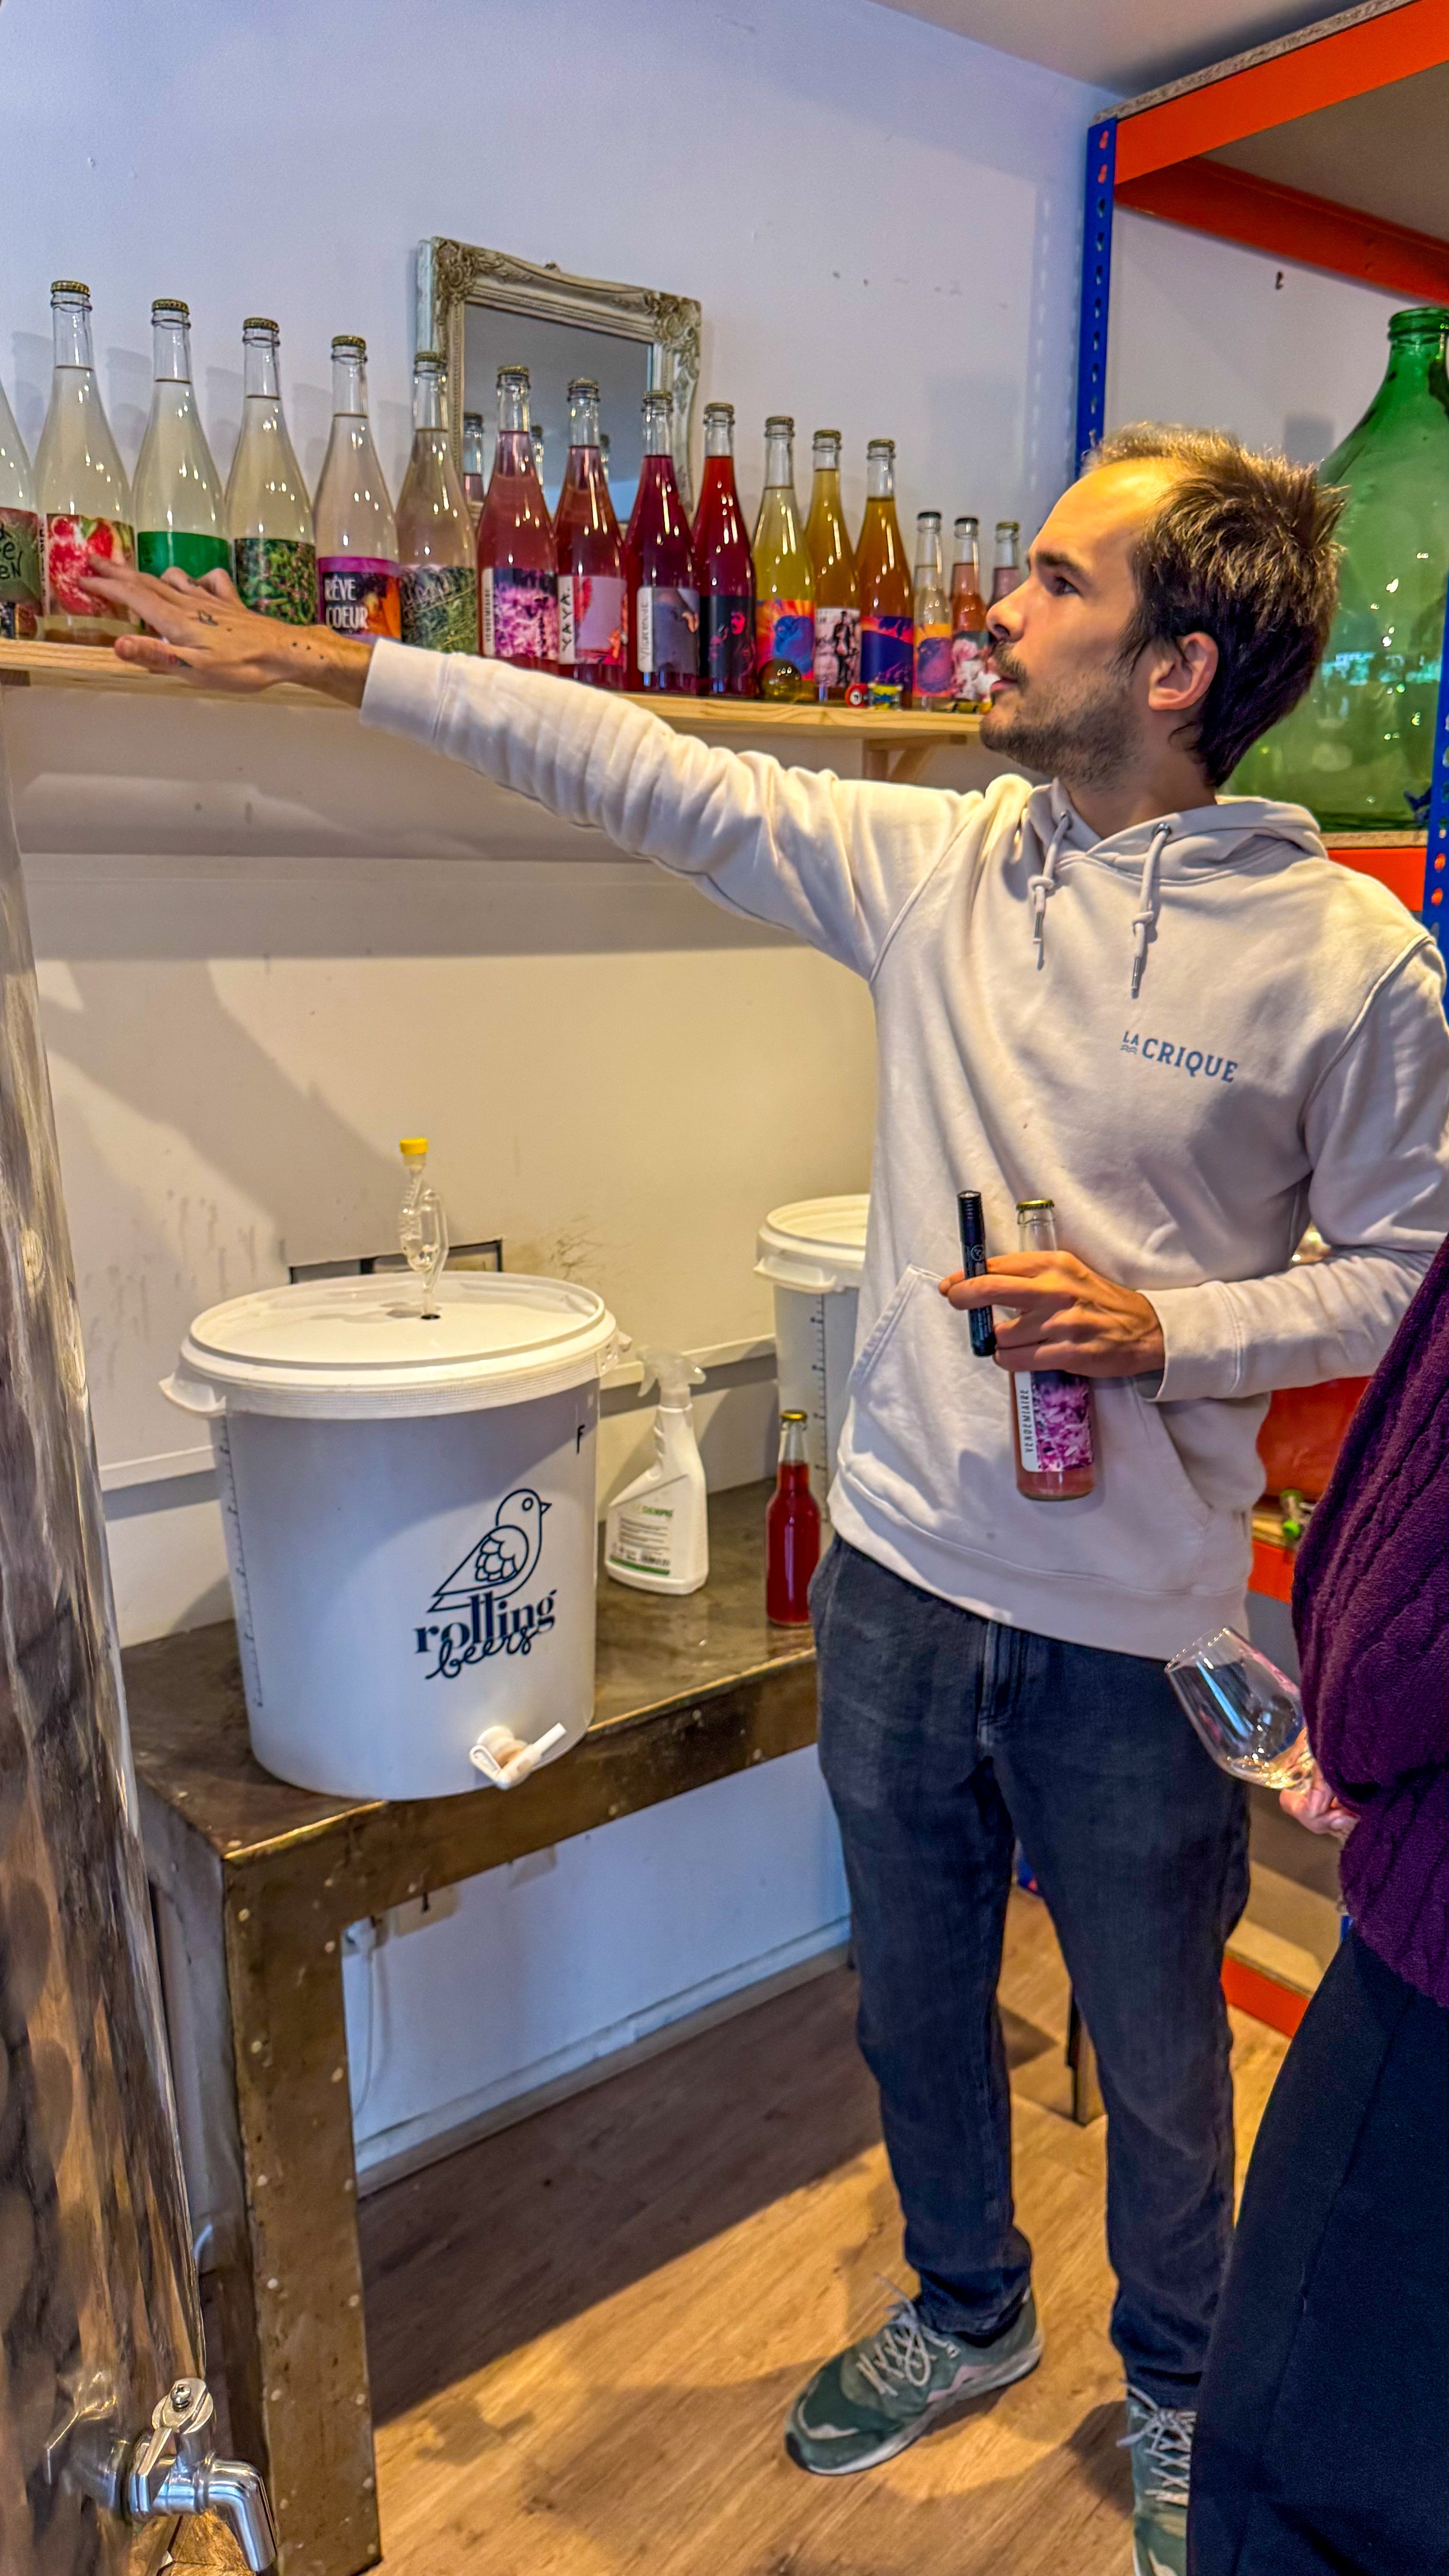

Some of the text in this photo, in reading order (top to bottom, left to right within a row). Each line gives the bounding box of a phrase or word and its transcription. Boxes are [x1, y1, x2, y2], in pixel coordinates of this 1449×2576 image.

[324, 573, 357, 601] RÊVE
[326, 605, 369, 630] COEUR
[1122, 1030, 1238, 1083] LA CRIQUE
[414, 1589, 557, 1654] rolling
[425, 1626, 538, 1679] beers
